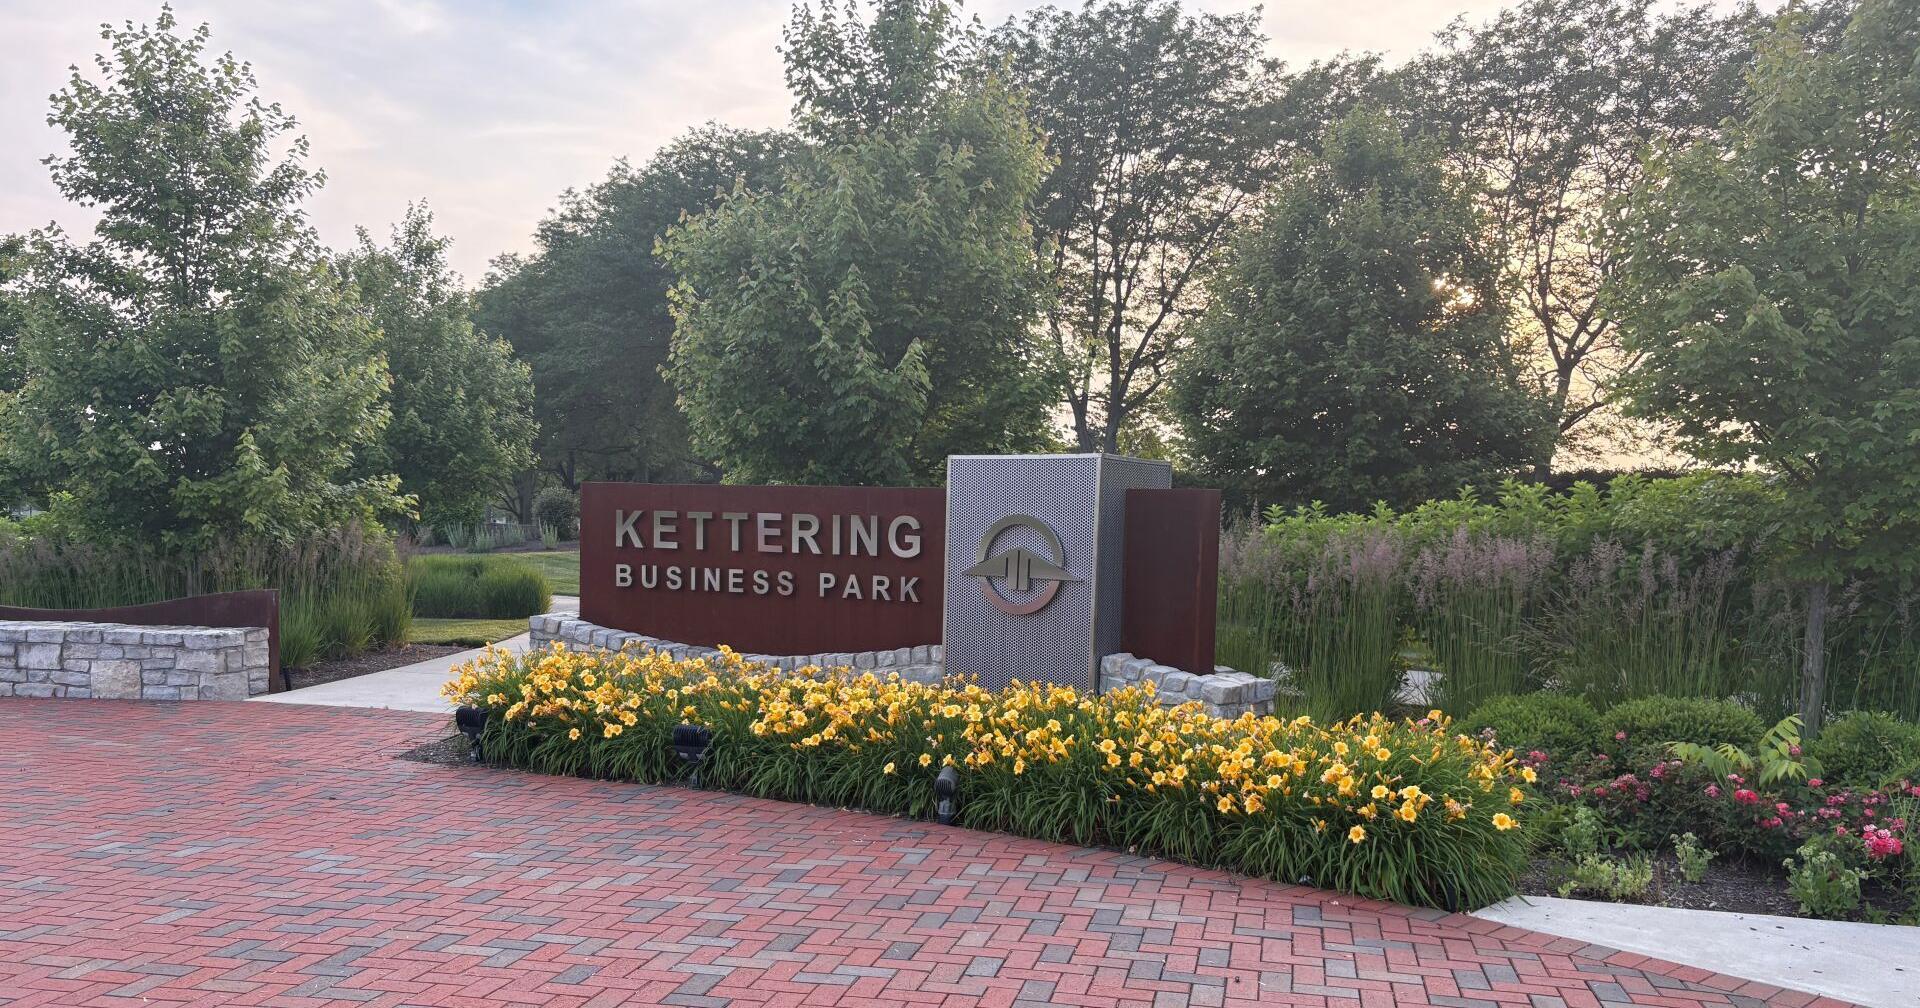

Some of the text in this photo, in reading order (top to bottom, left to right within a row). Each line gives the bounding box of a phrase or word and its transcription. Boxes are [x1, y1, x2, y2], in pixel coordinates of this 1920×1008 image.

[614, 509, 921, 559] KETTERING
[615, 563, 920, 603] BUSINESS PARK
